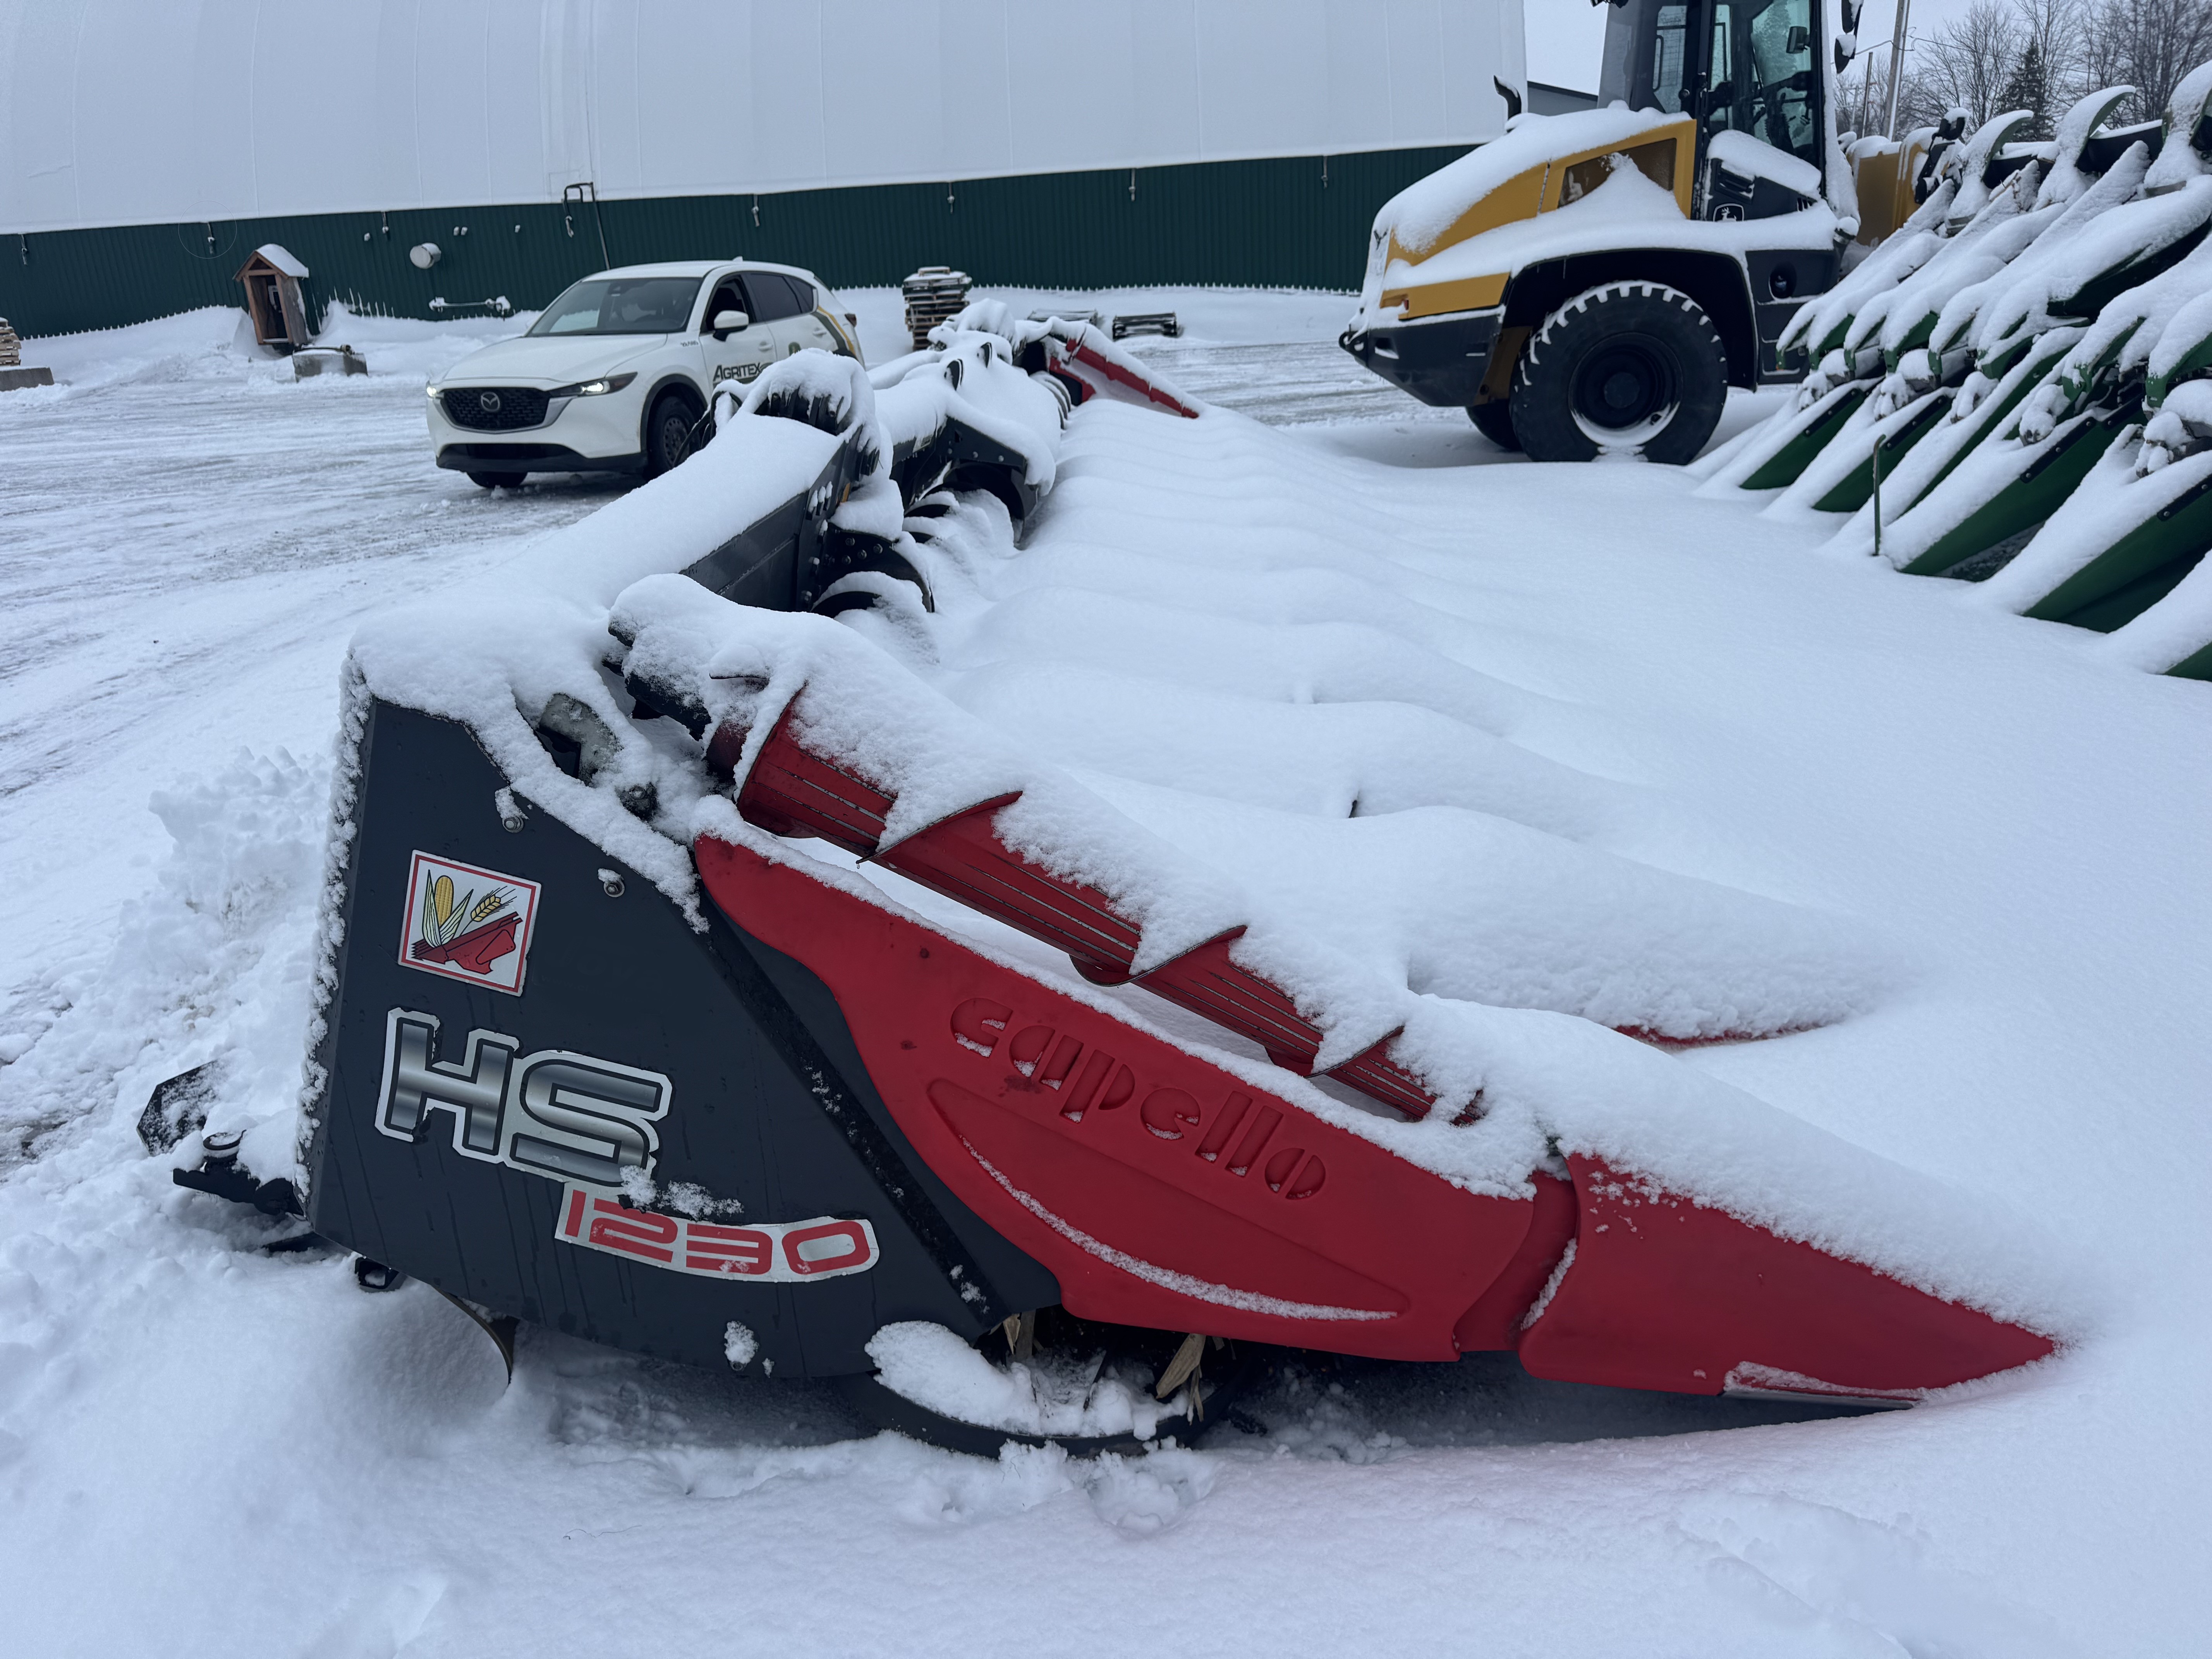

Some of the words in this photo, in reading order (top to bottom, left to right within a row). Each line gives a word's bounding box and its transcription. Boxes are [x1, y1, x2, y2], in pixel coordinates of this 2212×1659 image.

[713, 362, 761, 381] AGRITEX
[383, 1015, 665, 1188] HS
[565, 1189, 871, 1275] 1230
